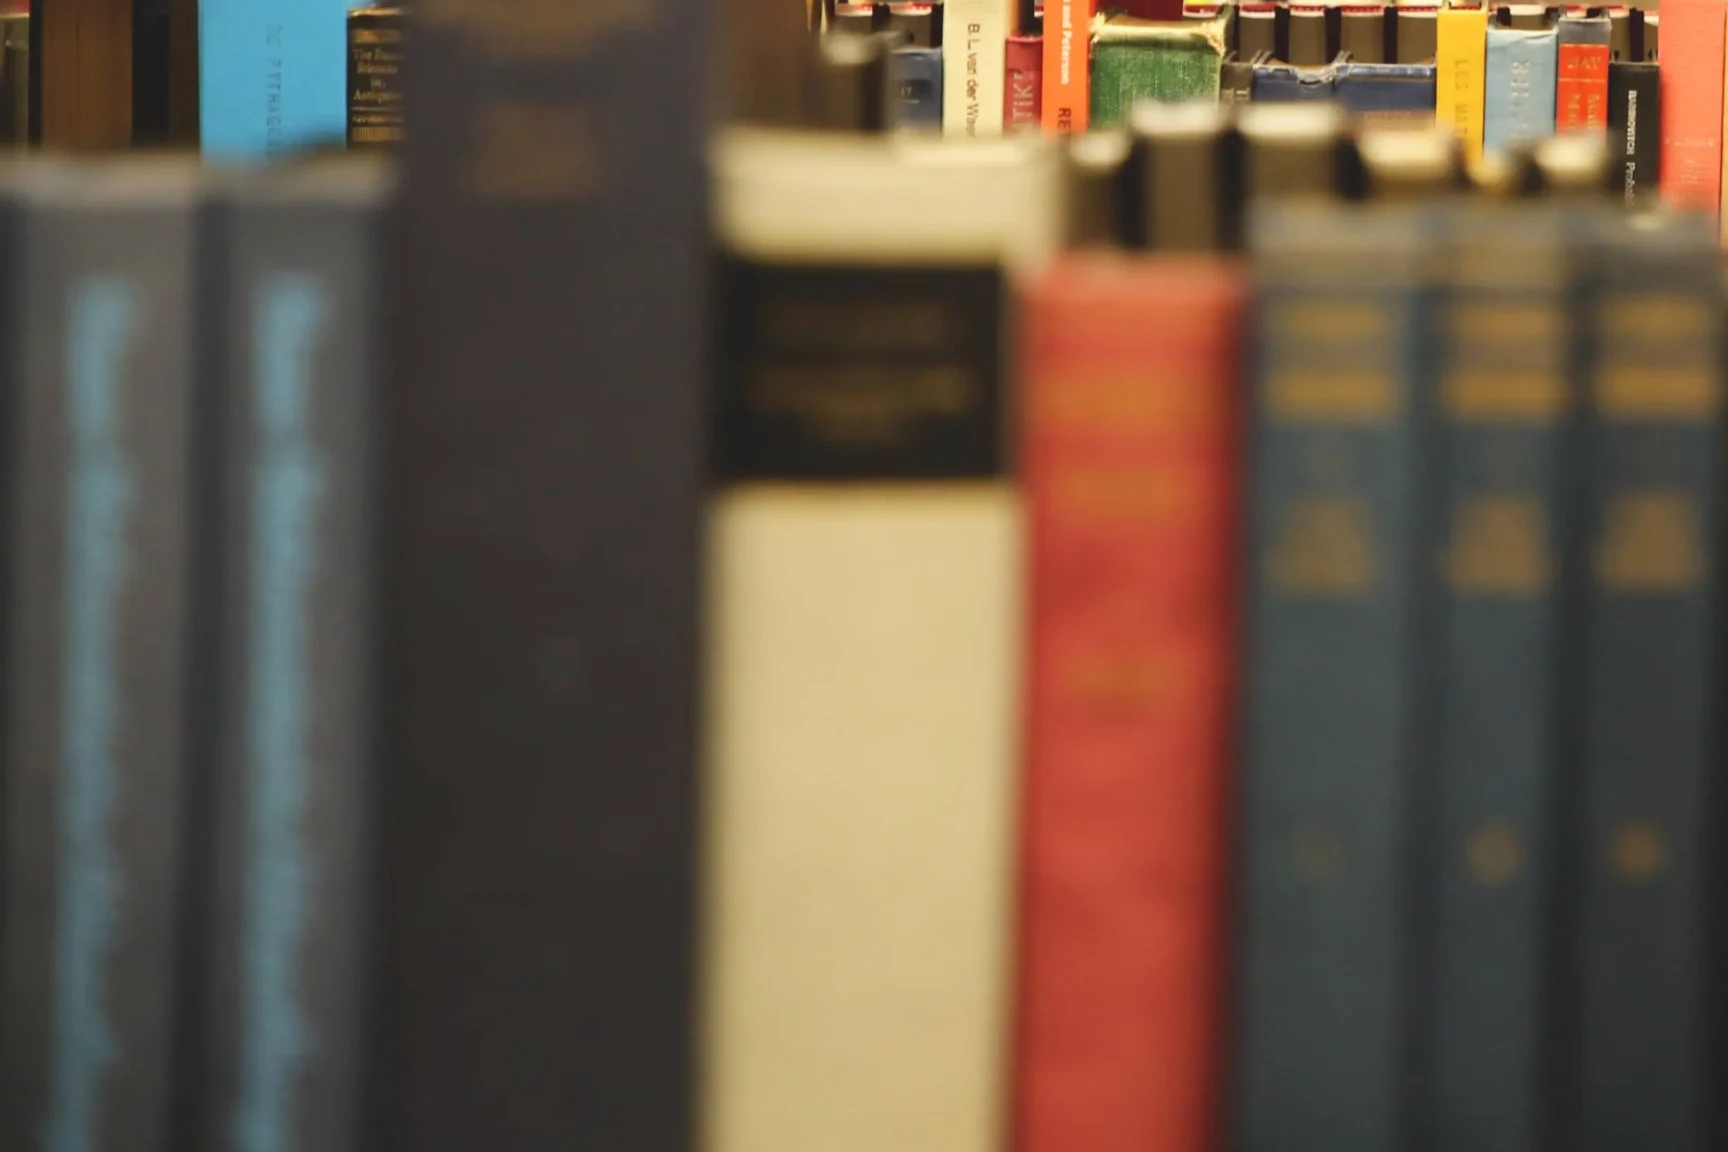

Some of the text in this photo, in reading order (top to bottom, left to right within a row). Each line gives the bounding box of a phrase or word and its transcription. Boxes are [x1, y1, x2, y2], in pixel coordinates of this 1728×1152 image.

[1062, 5, 1073, 29] and
[967, 53, 978, 75] van
[1060, 31, 1073, 85] Peterson
[967, 79, 980, 102] der
